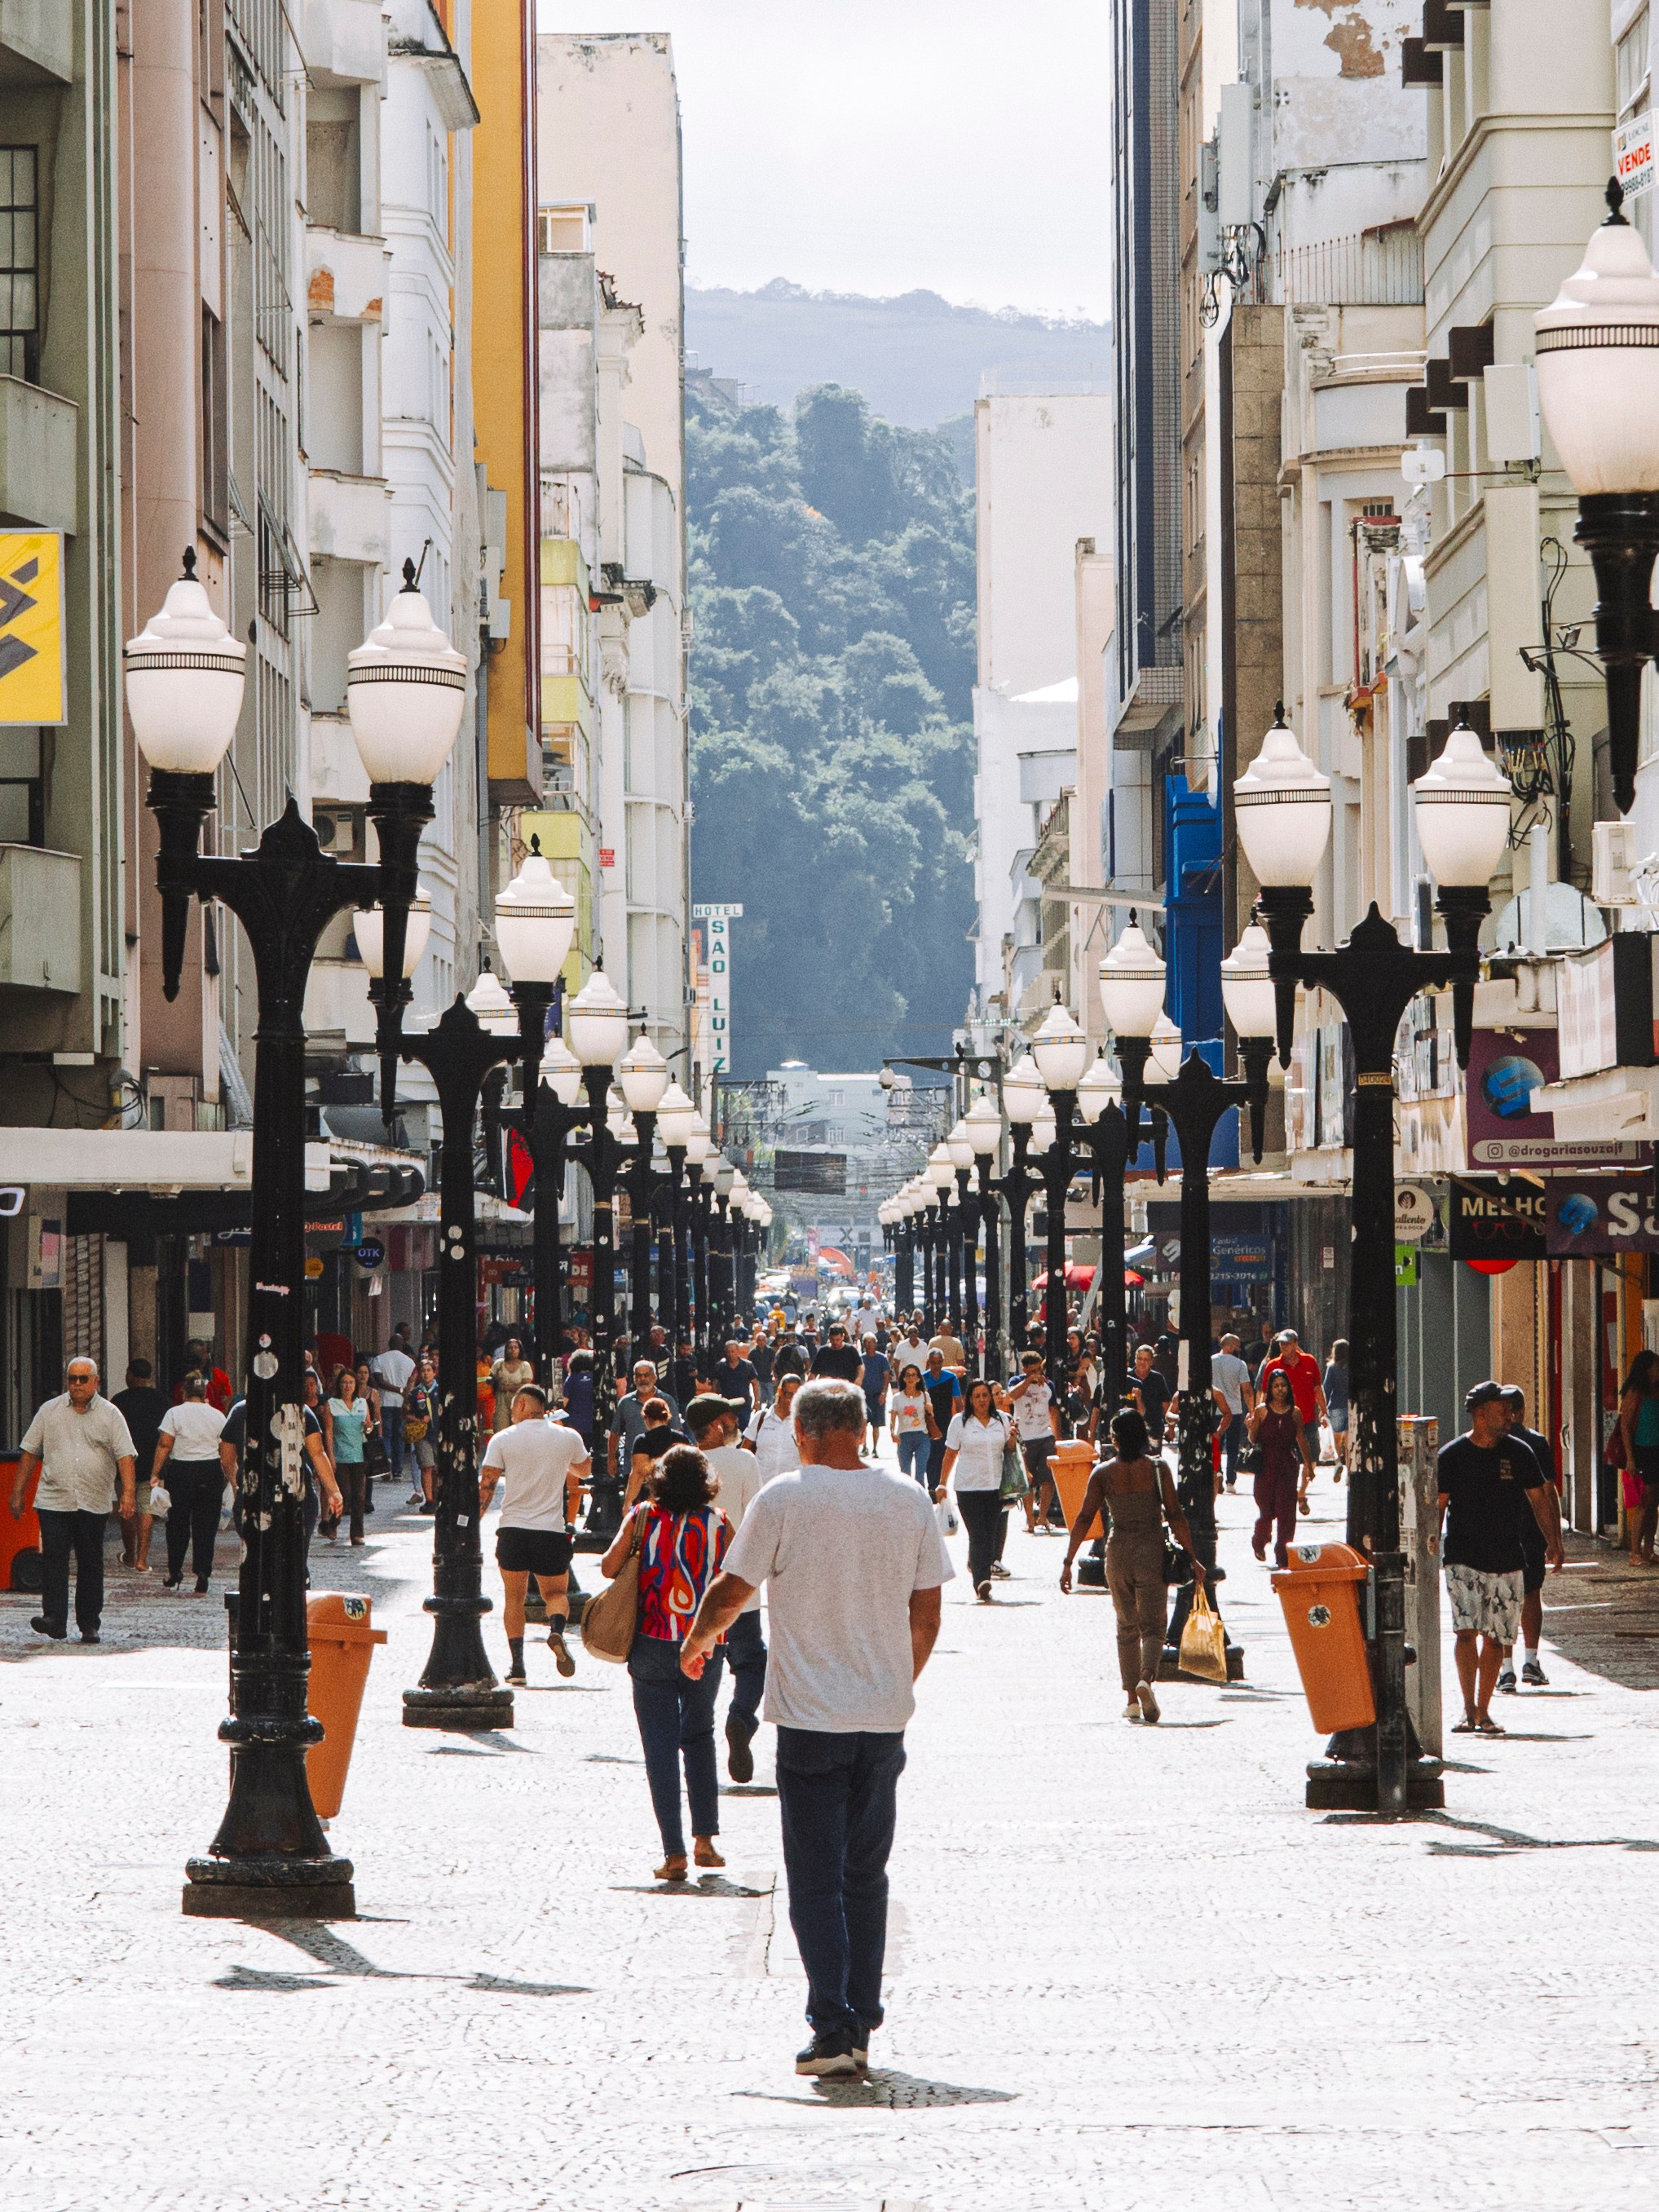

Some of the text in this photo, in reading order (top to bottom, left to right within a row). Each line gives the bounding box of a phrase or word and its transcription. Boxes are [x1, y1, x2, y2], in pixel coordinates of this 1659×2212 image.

[1618, 142, 1651, 175] VENDE
[695, 906, 739, 916] HOTEL
[712, 921, 726, 1071] SÃO LUIZ
[1508, 1142, 1623, 1158] @drogariasouzajf
[358, 1248, 380, 1257] OTK
[1212, 1244, 1265, 1256] Genéricos
